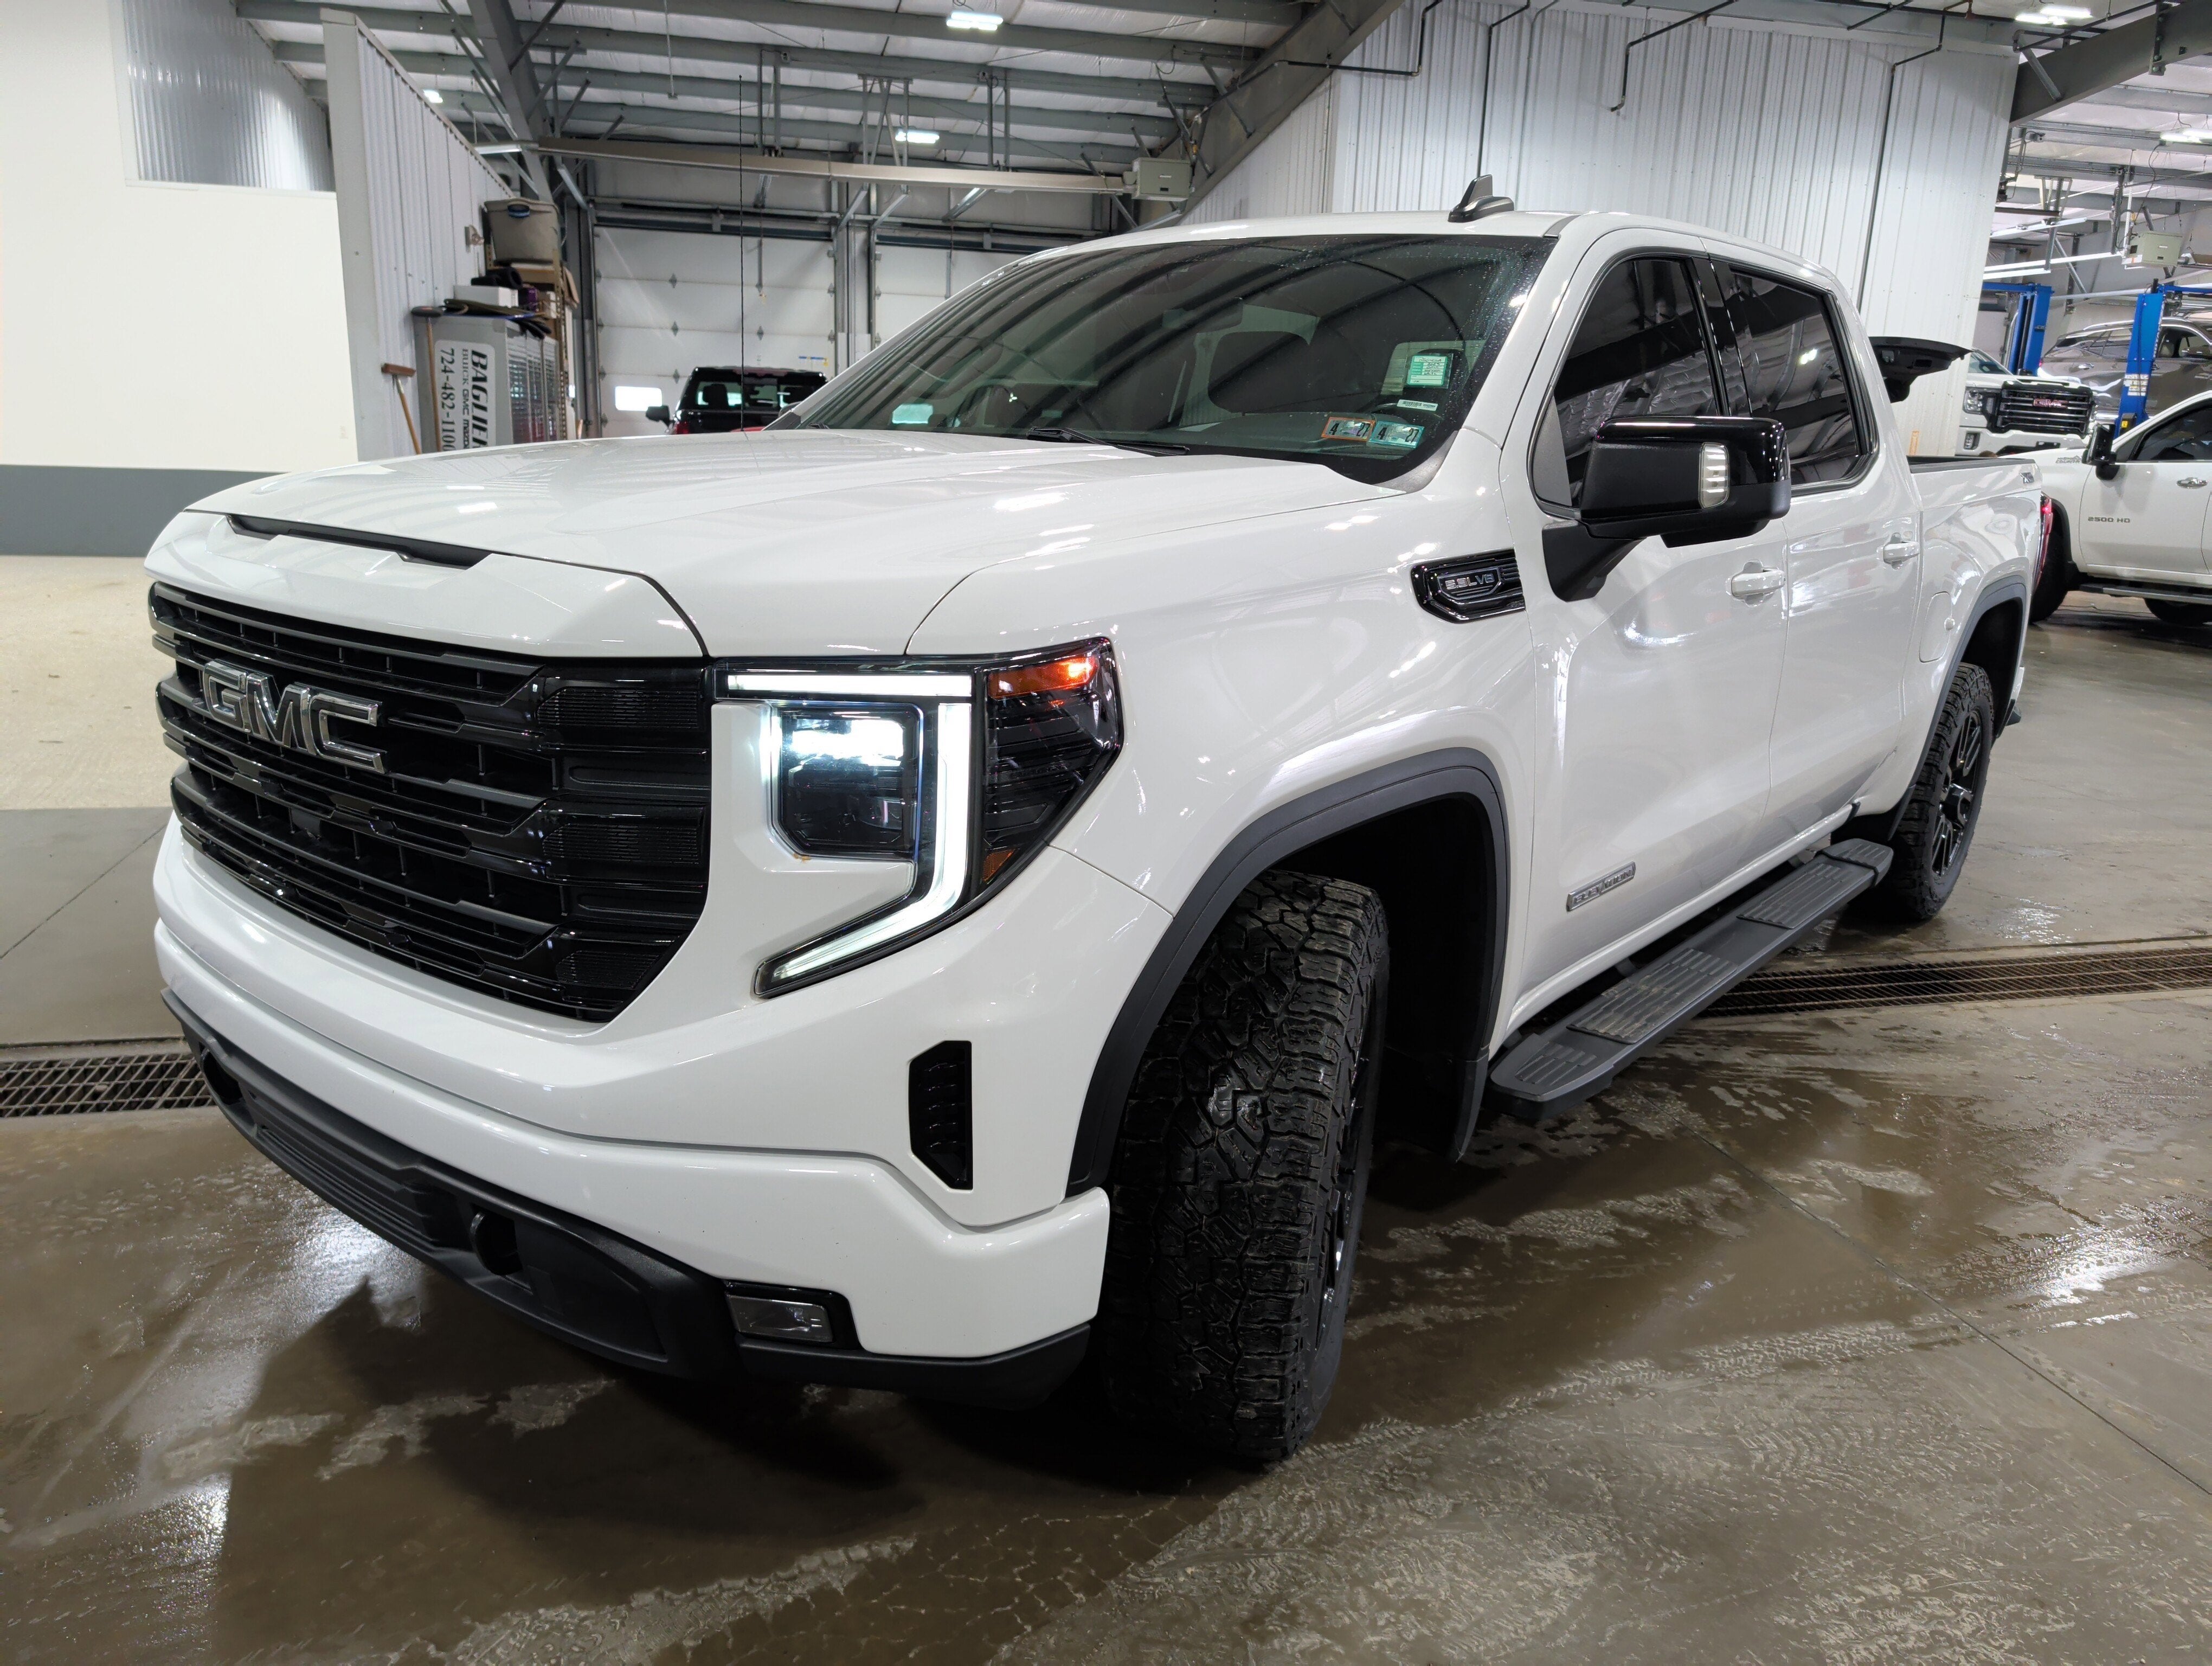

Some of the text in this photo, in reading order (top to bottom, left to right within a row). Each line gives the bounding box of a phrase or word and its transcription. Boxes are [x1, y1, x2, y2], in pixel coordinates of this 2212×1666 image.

[1329, 422, 1371, 437] 4 27
[1378, 427, 1419, 443] 4 27
[203, 659, 386, 774] GMC
